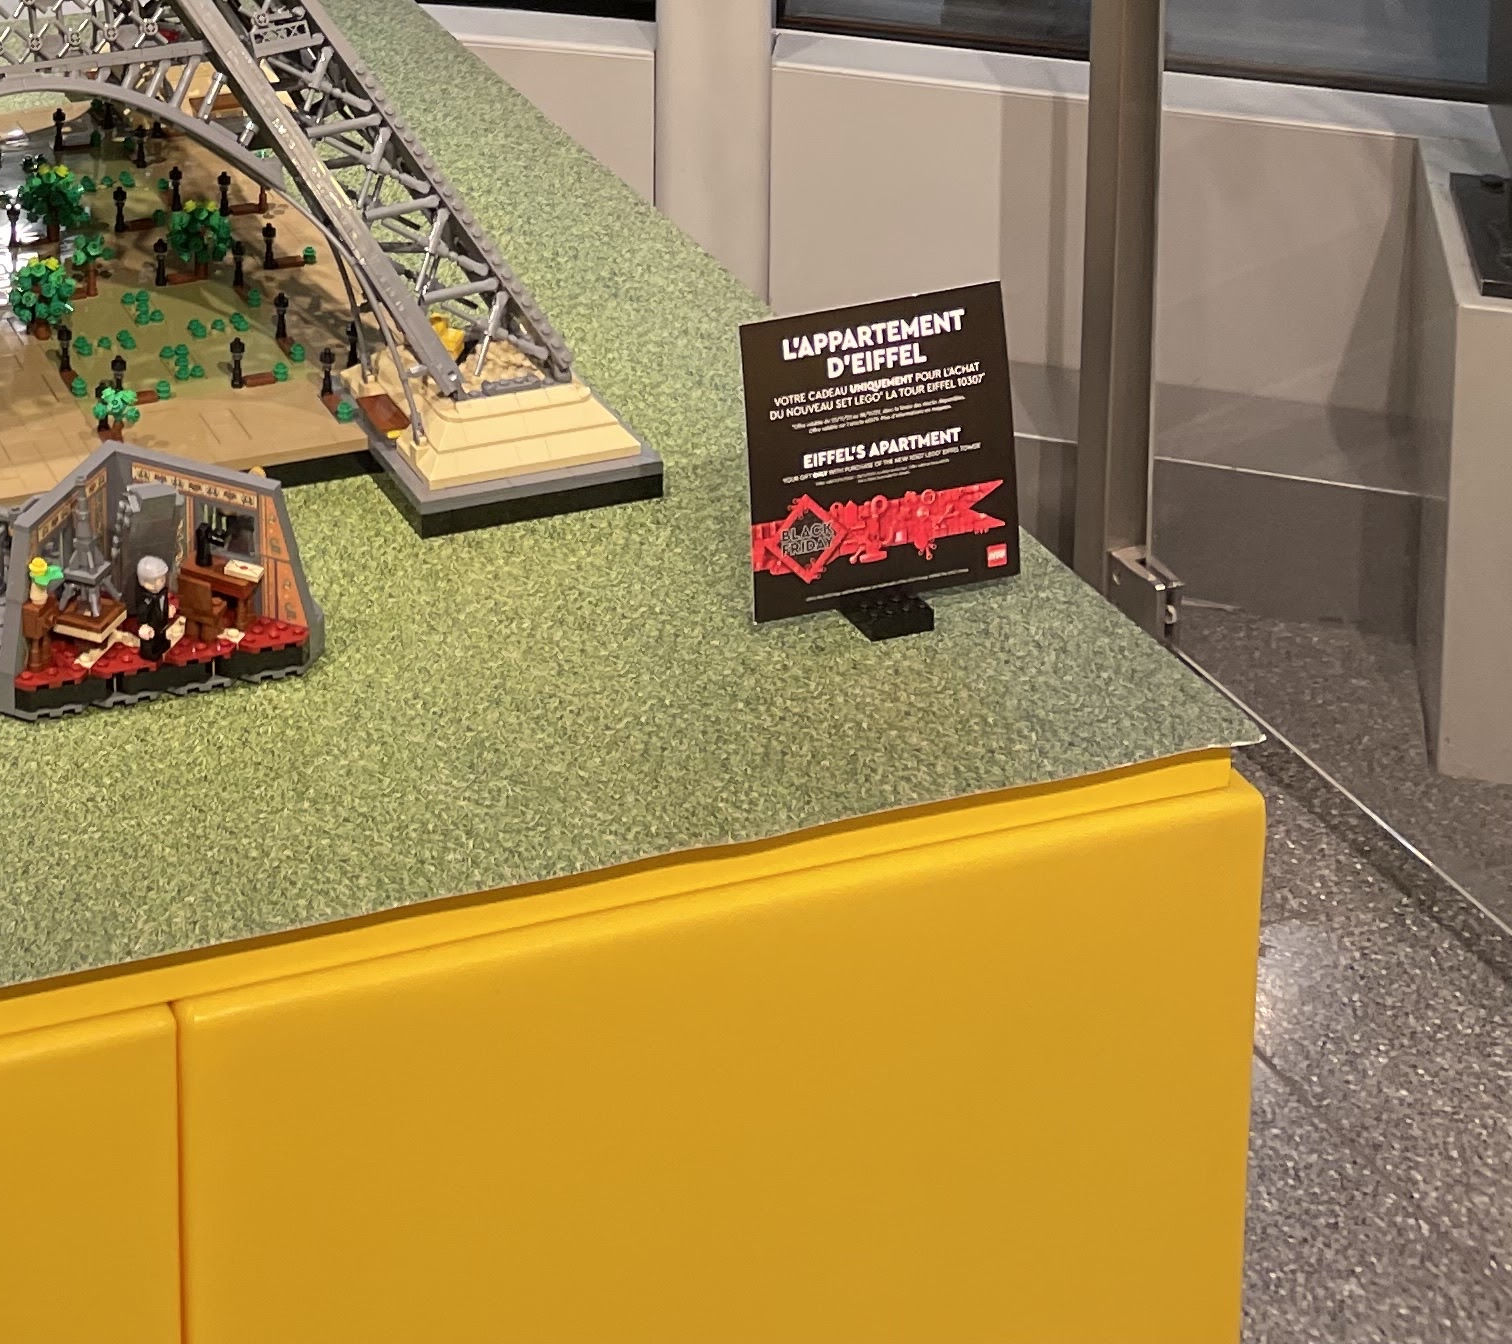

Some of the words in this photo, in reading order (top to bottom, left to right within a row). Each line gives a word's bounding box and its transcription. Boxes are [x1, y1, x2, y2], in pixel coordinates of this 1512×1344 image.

[782, 308, 965, 361] L'APPARTEMENT
[826, 342, 928, 379] D'EIFFEL
[769, 409, 784, 421] DU
[786, 400, 834, 418] NOUVEAU
[835, 397, 853, 410] SET
[885, 390, 898, 400] LA
[898, 385, 925, 398] TOUR
[926, 379, 957, 393] EIFFEL
[773, 392, 807, 407] VOTRE
[807, 385, 848, 402] CADEAU
[849, 373, 914, 393] UNIQUEMENT
[915, 369, 941, 383] POUR
[943, 361, 980, 378] L'ACHAT
[803, 445, 866, 469] EIFFEL'S
[869, 427, 962, 458] APARTMENT
[781, 520, 838, 542] BLACK
[781, 536, 834, 558] FRIDAY
